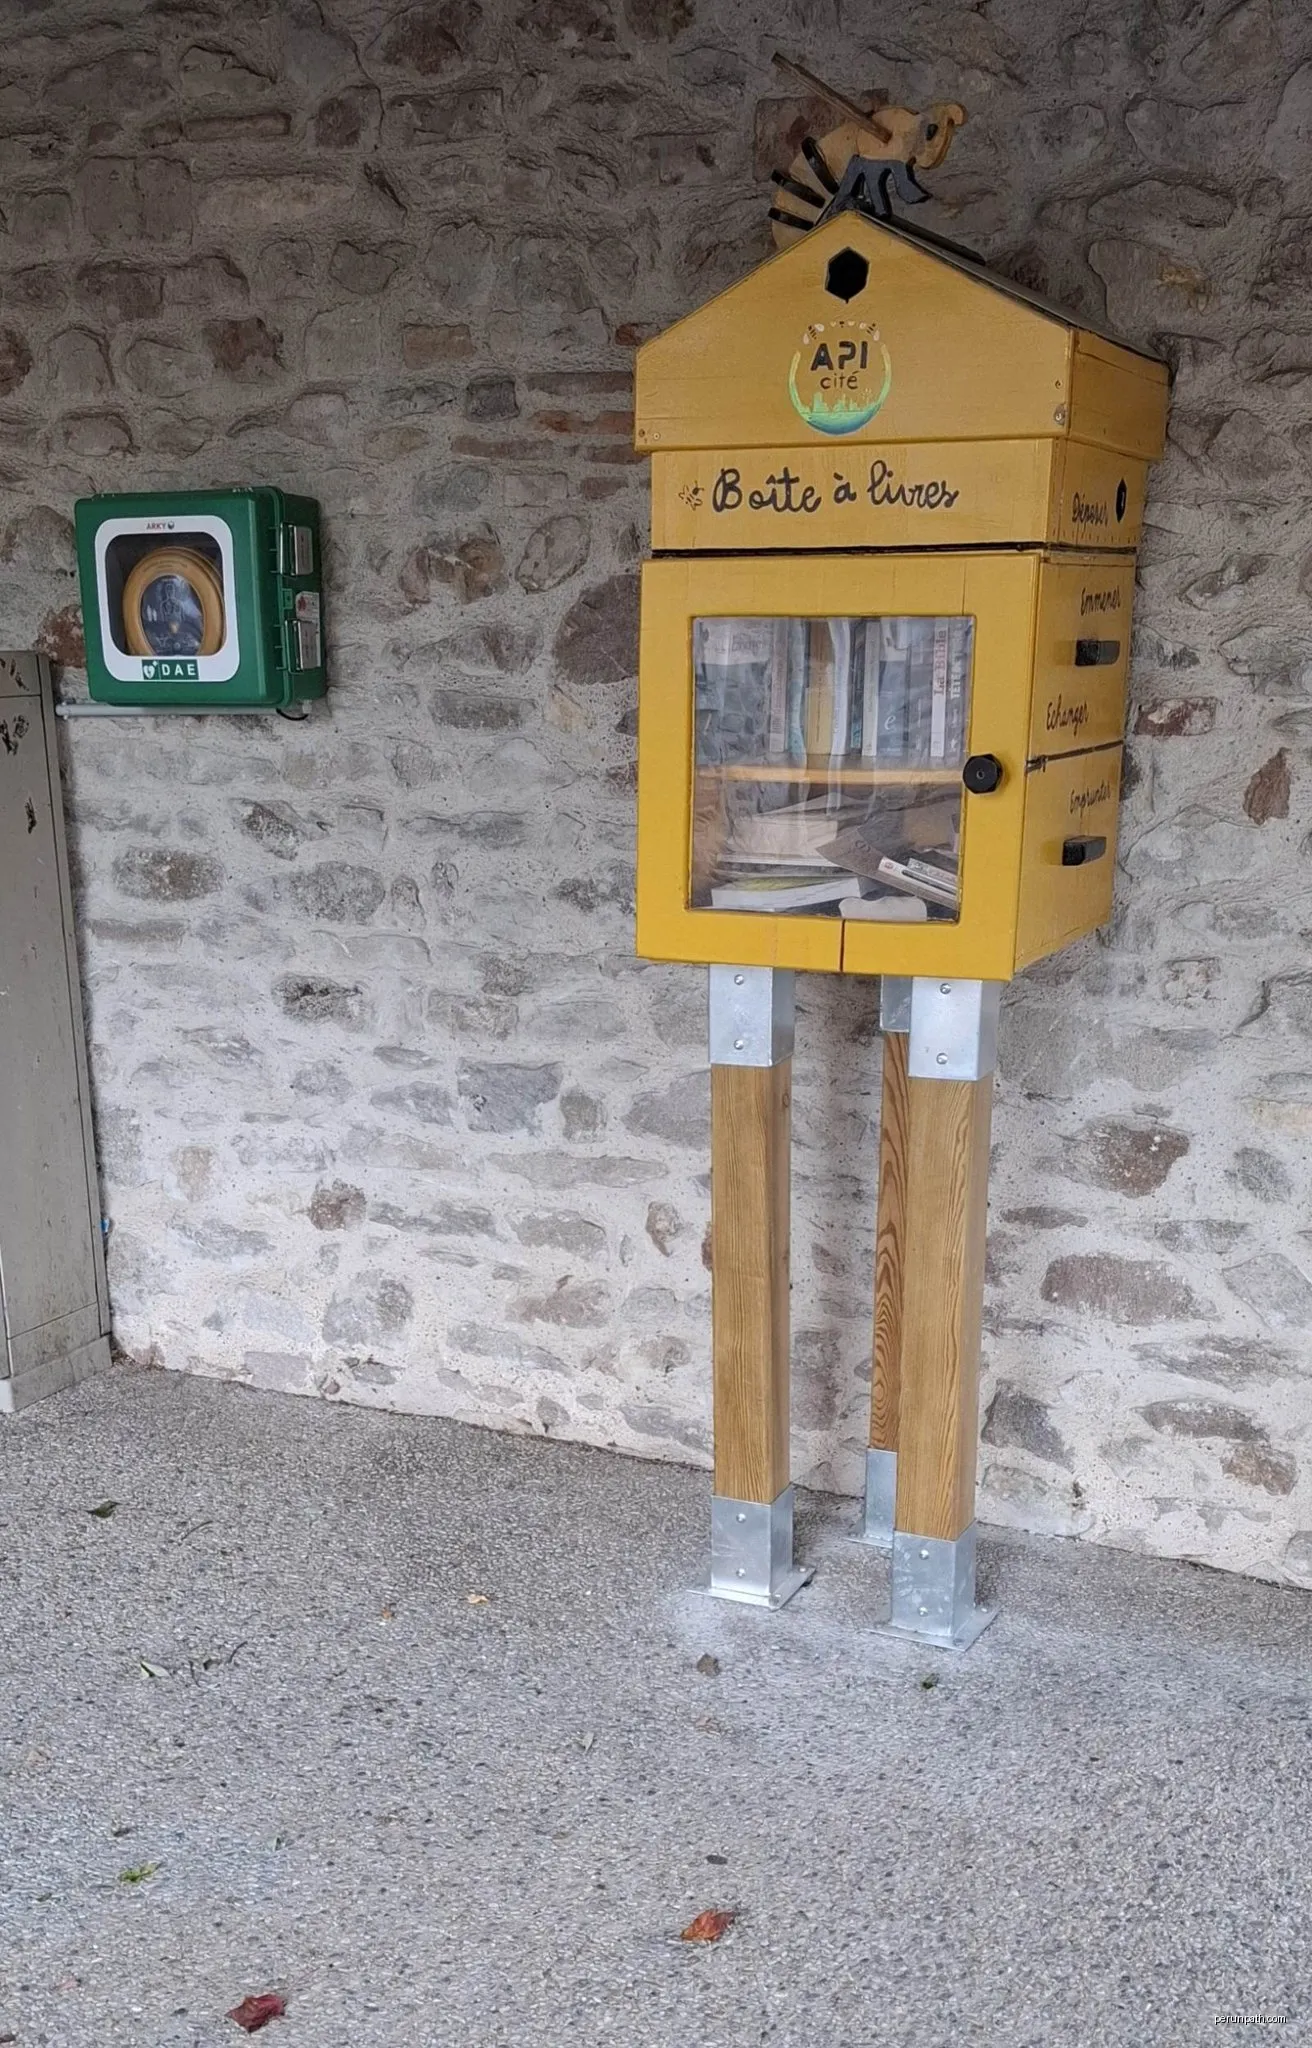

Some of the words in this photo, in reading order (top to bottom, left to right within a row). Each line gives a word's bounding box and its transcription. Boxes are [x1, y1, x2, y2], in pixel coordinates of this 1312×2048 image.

[810, 341, 869, 371] API
[819, 371, 859, 390] cité
[712, 466, 822, 513] Boîte
[832, 472, 857, 503] à
[866, 459, 959, 509] livres
[934, 630, 947, 671] Bible
[161, 662, 197, 677] DAE
